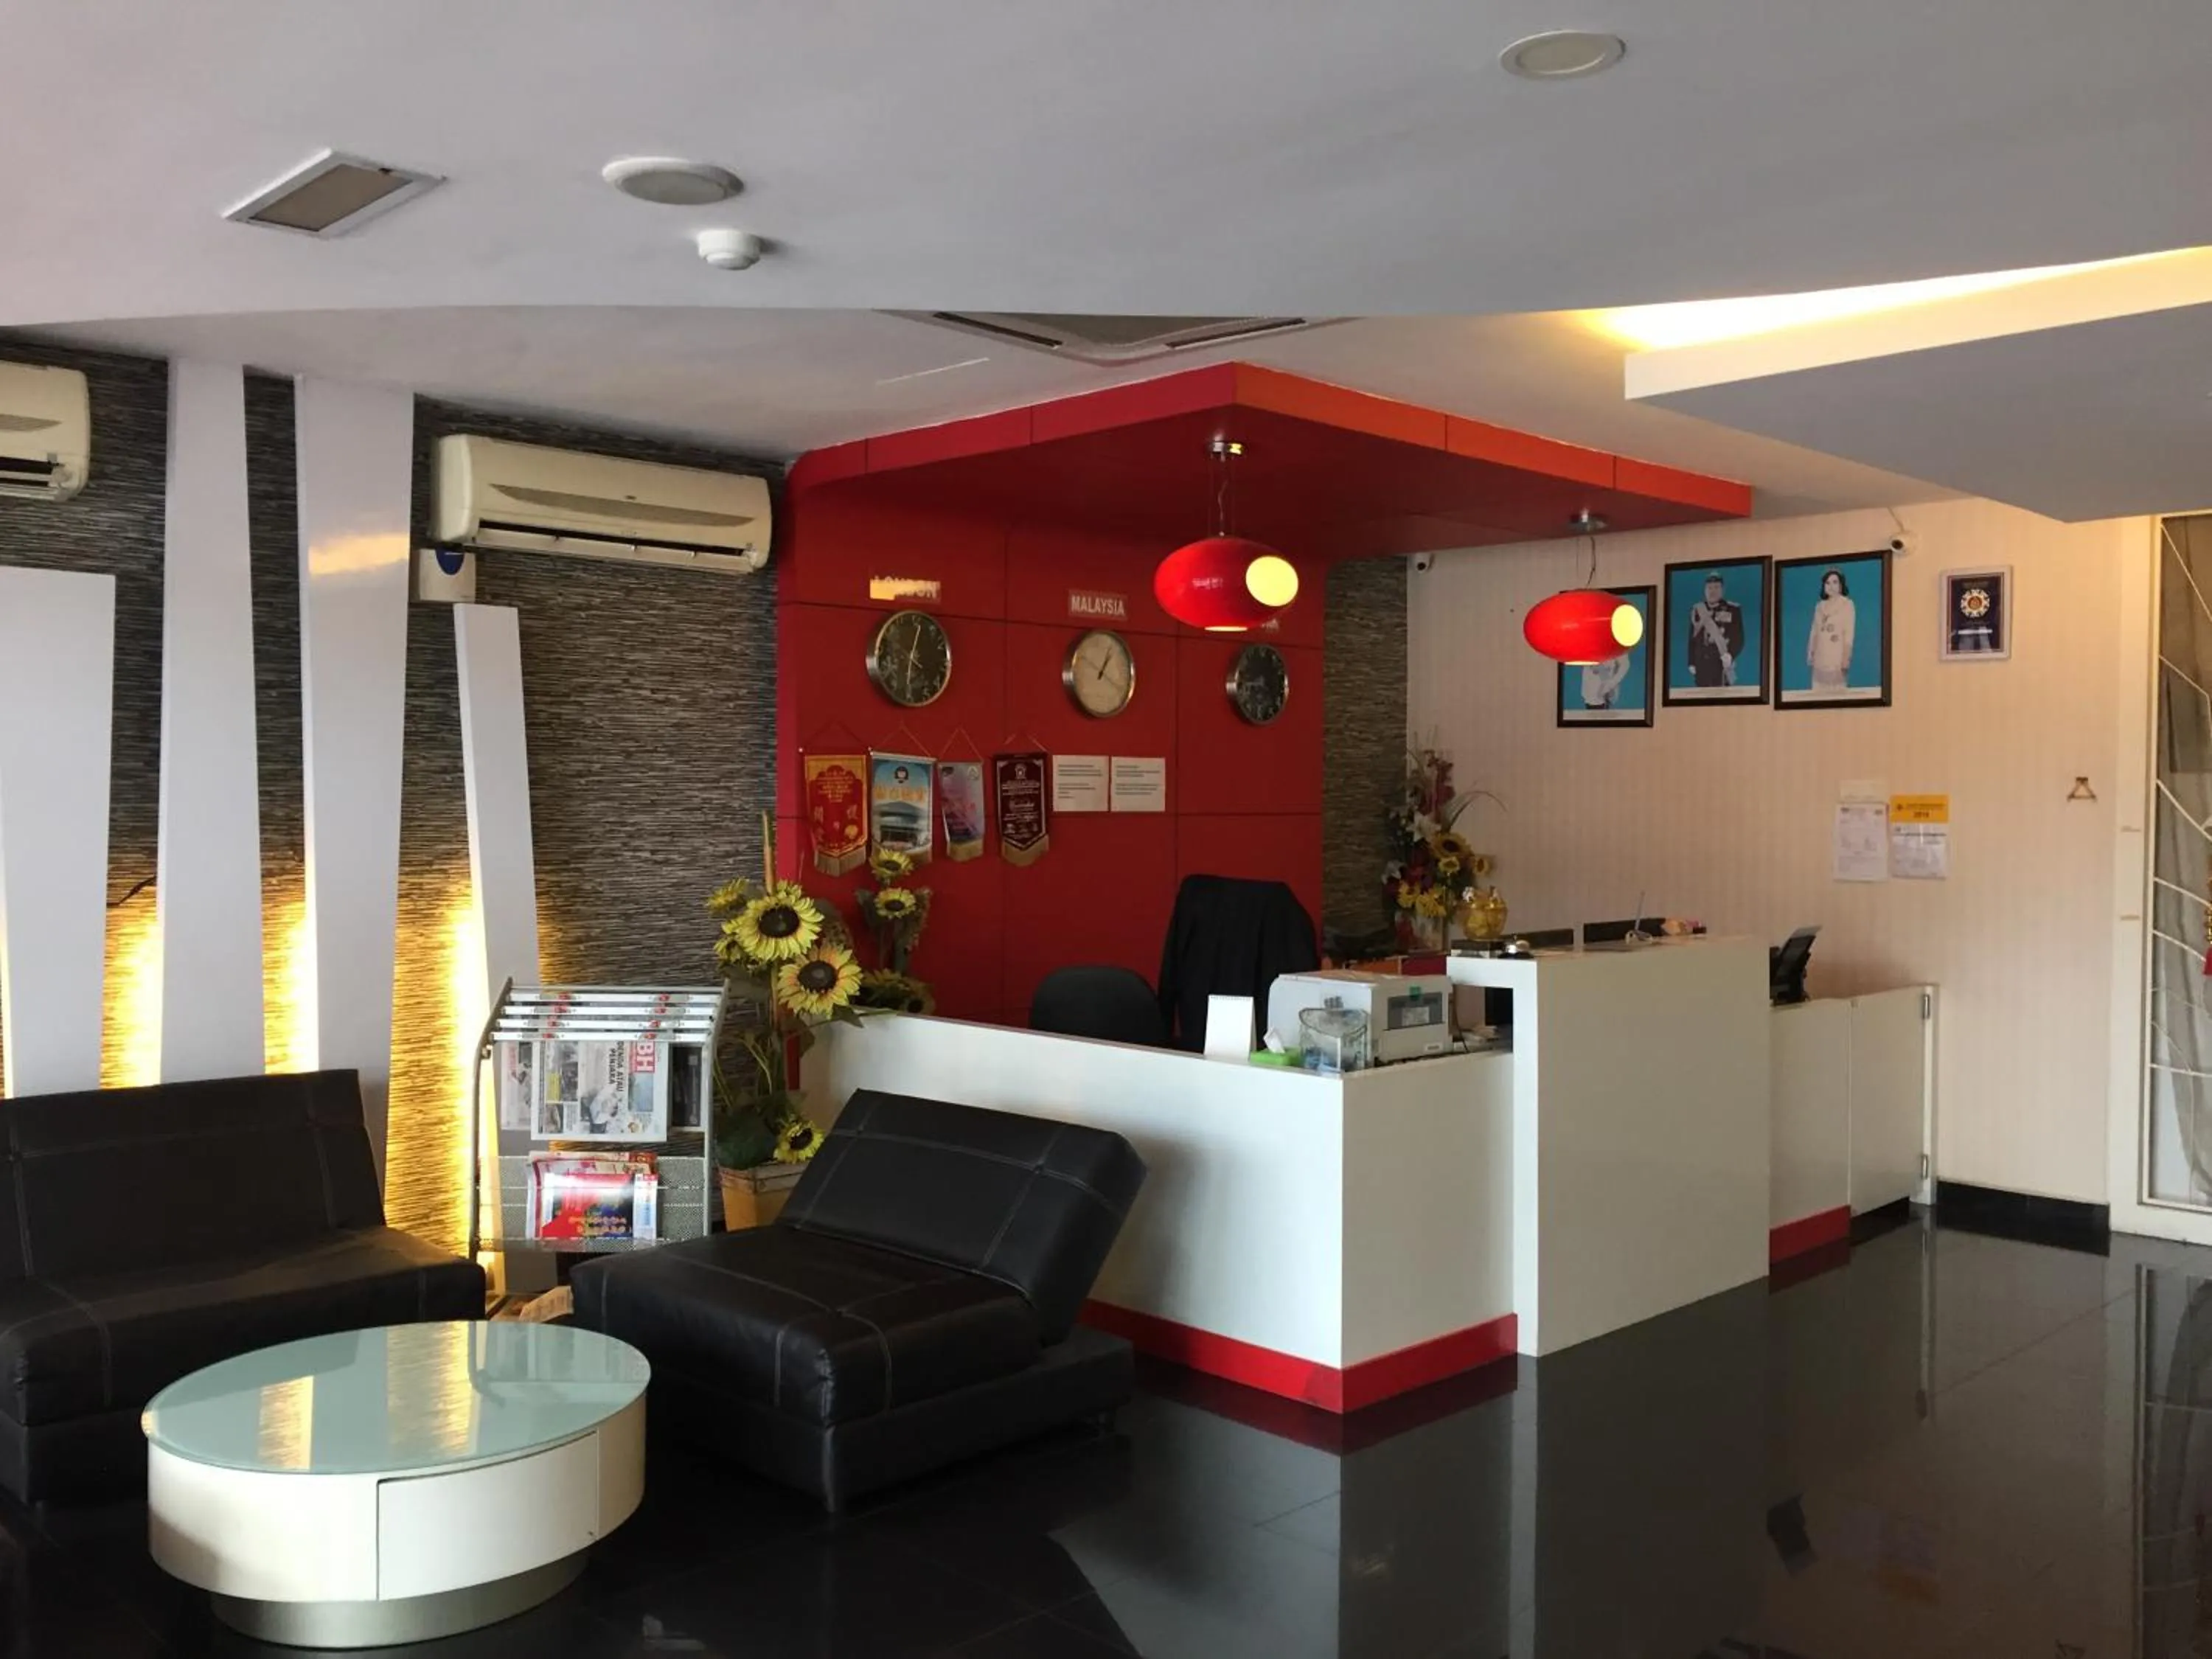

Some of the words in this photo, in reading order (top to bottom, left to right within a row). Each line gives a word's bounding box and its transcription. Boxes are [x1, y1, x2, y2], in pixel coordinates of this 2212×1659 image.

[1071, 594, 1125, 617] MALAYSIA
[608, 1048, 617, 1085] PENJARA
[636, 1040, 654, 1072] BH
[616, 1071, 625, 1092] ATAU
